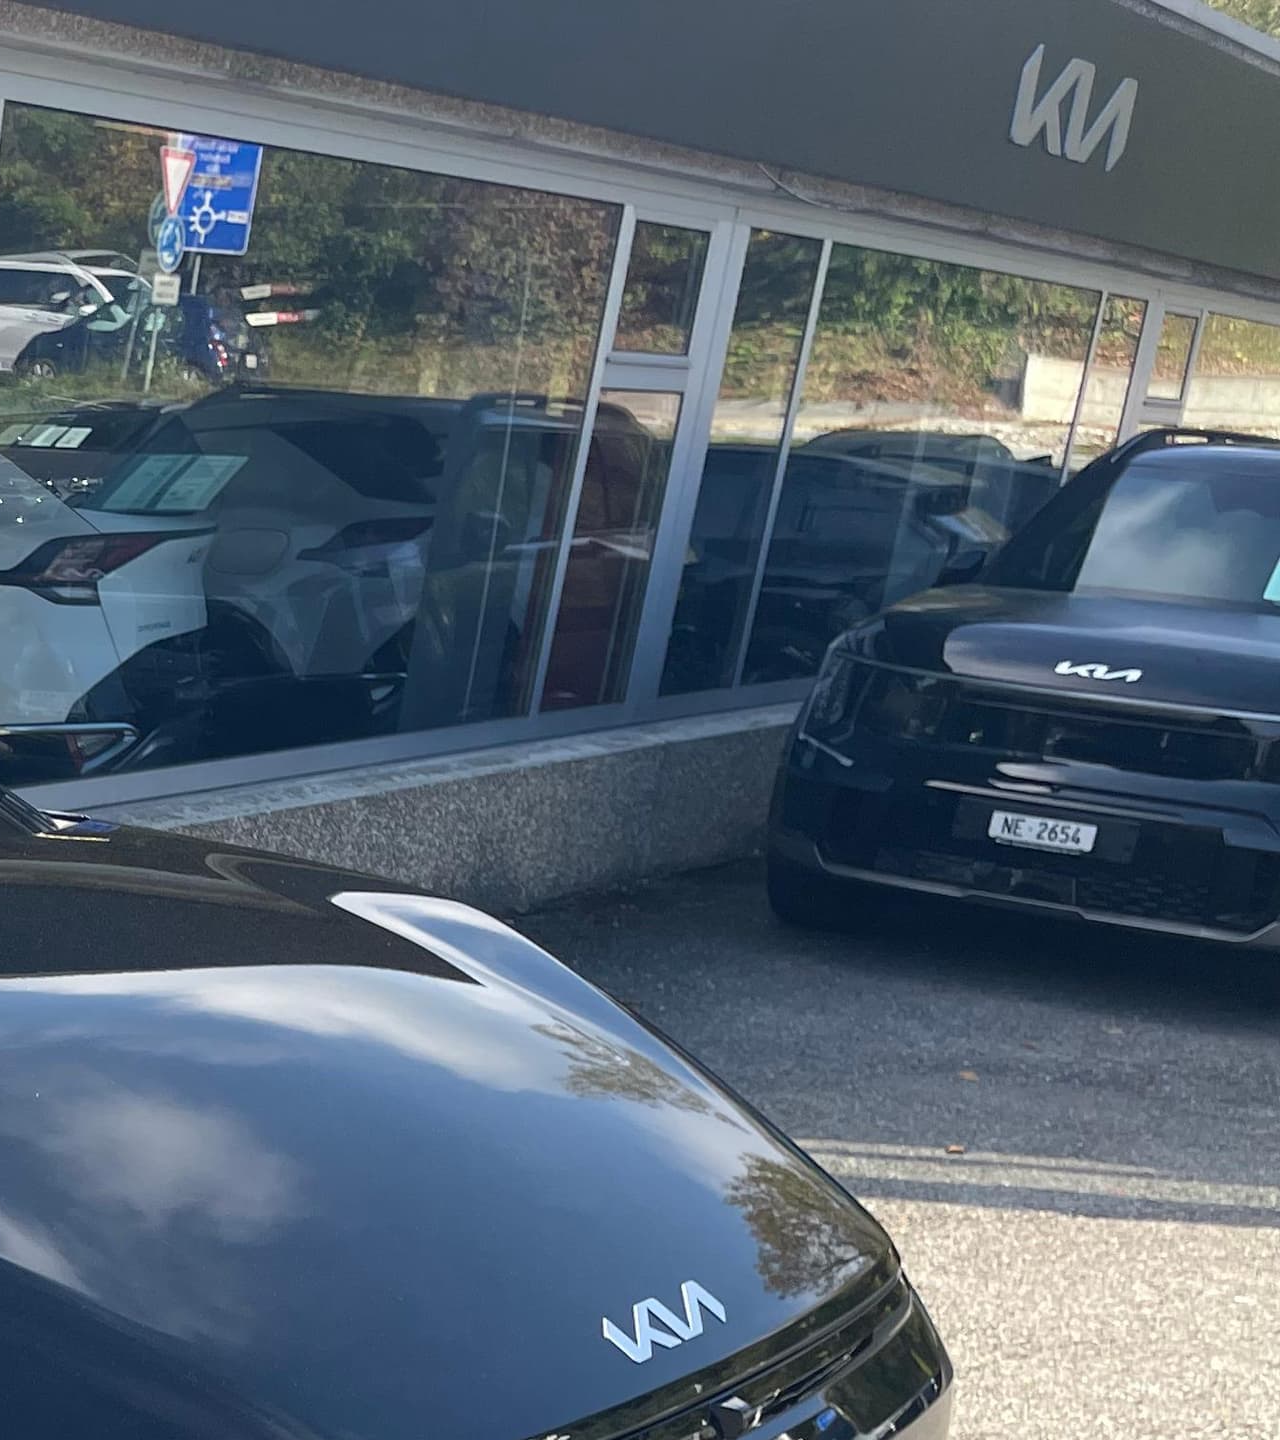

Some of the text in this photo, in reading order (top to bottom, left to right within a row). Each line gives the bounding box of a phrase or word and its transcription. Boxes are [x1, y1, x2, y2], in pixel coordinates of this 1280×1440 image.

[1009, 43, 1139, 173] KIA
[1001, 815, 1081, 845] NE 2654
[602, 1279, 727, 1364] KIA
